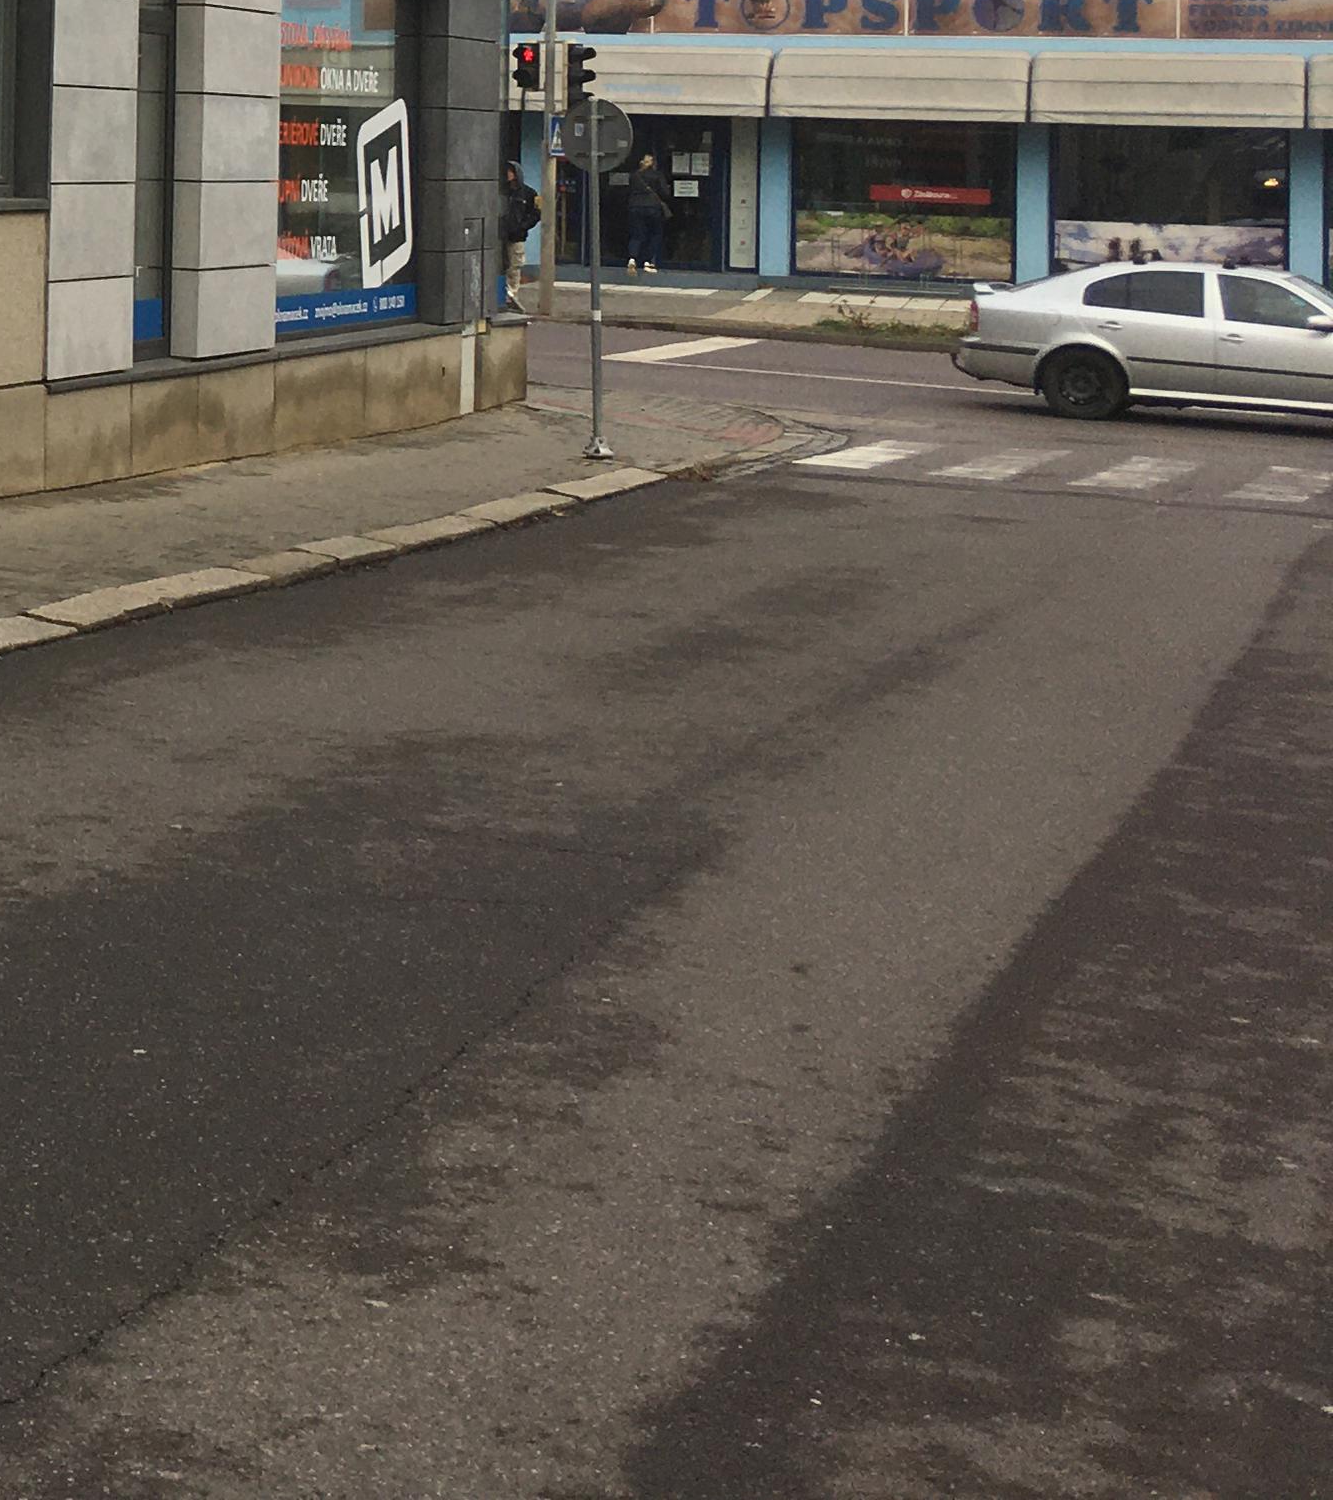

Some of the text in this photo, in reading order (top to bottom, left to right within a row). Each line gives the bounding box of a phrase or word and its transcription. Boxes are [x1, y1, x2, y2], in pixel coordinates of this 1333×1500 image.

[320, 67, 345, 90] OKNA
[353, 65, 379, 93] DVEŘE
[320, 118, 347, 147] DVEŘE
[301, 173, 329, 202] DVEŘE
[310, 236, 338, 260] VRATA
